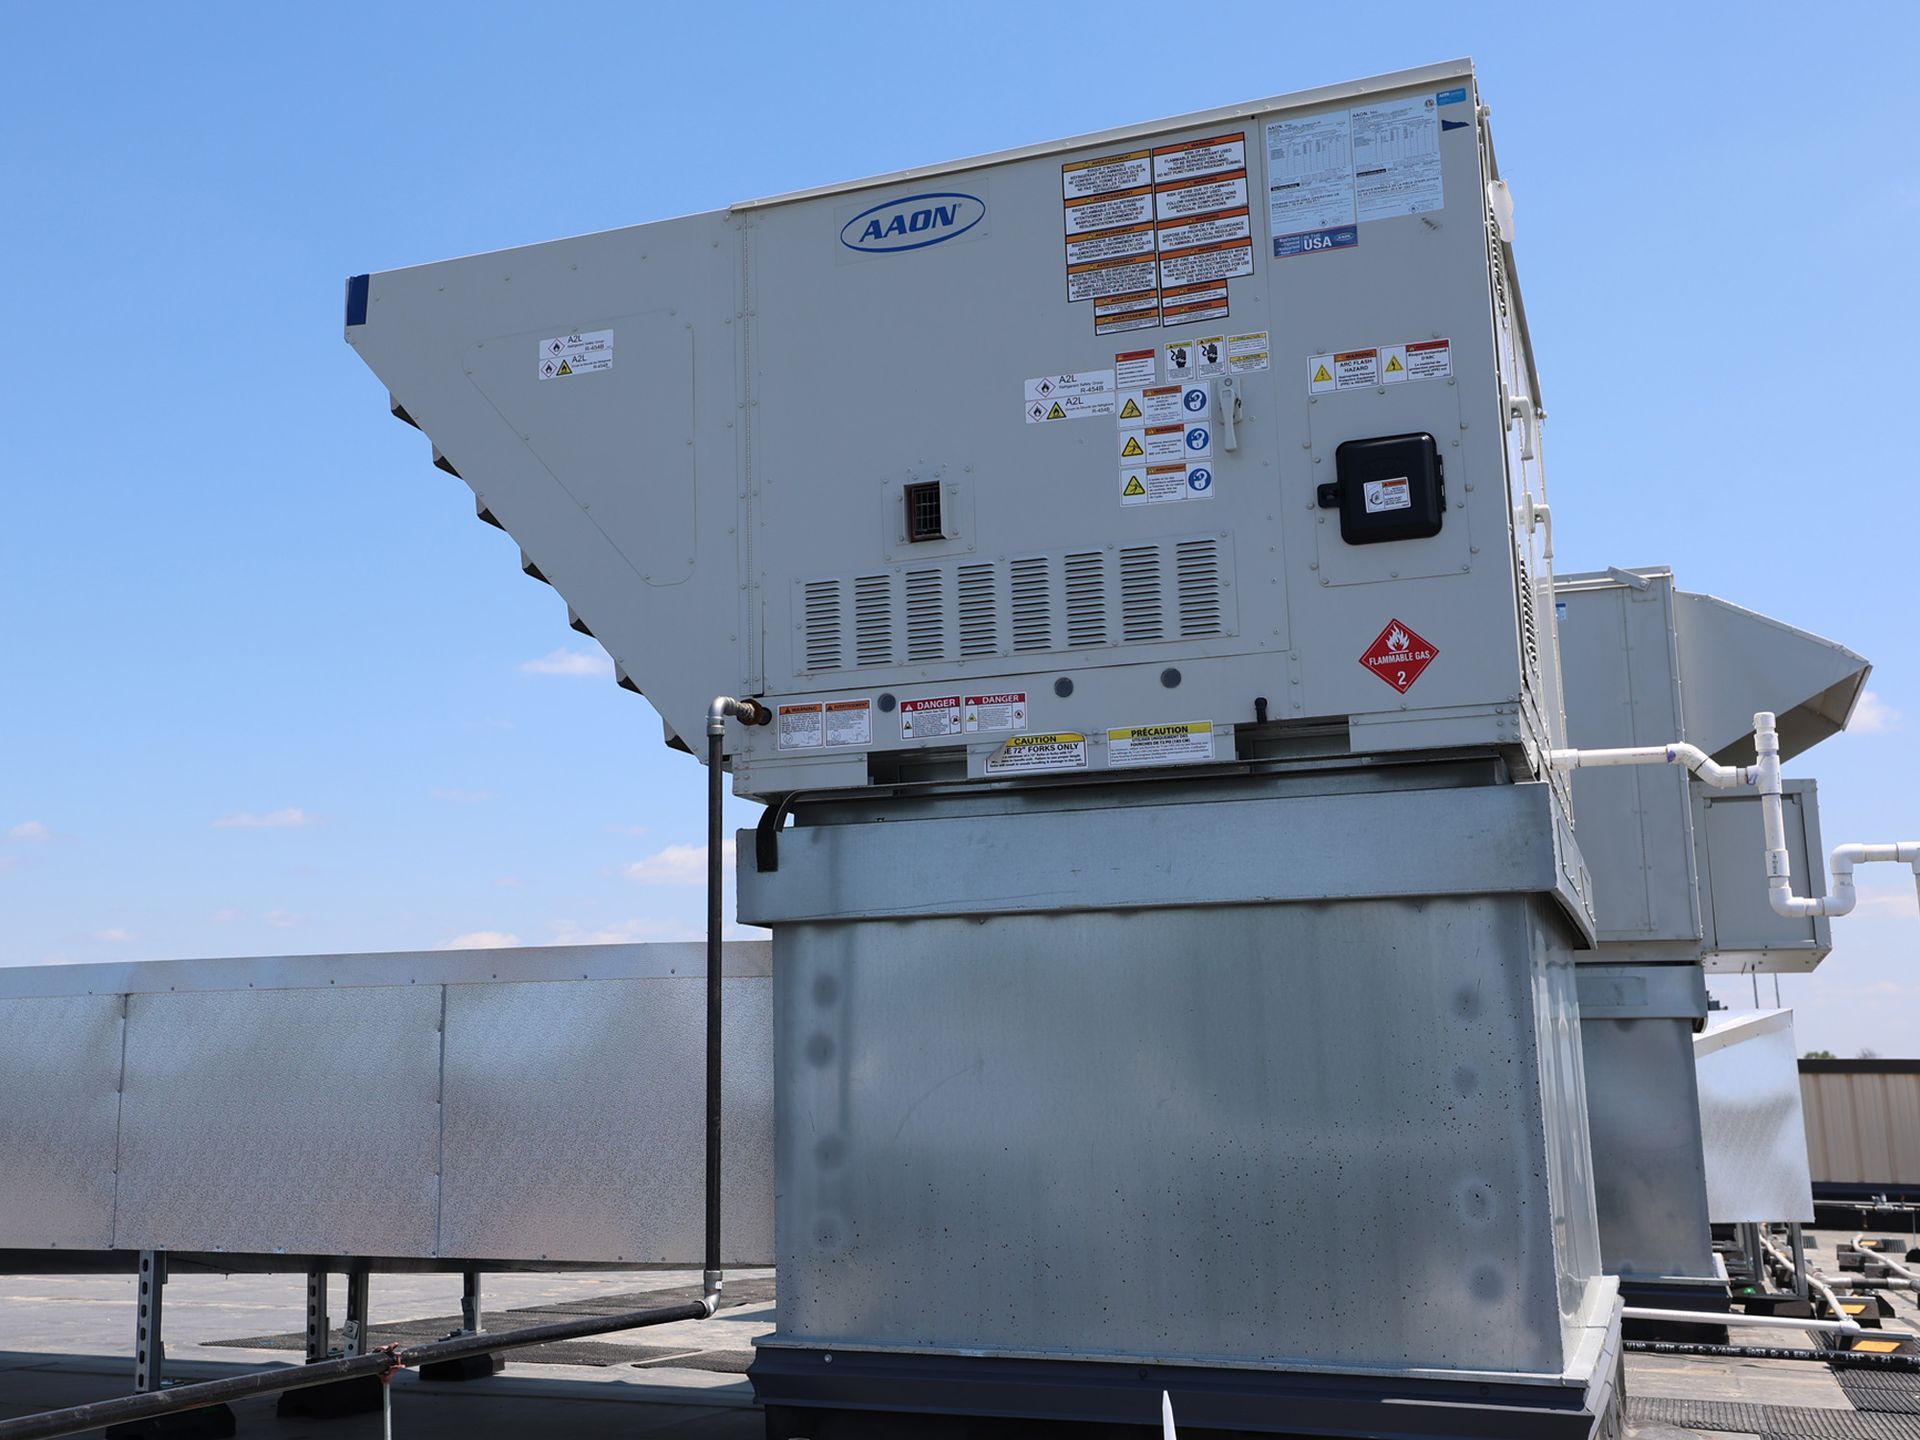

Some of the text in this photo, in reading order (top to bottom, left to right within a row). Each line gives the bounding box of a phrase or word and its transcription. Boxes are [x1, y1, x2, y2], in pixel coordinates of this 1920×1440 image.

[858, 203, 957, 242] AAON
[1304, 236, 1331, 250] USA
[568, 335, 582, 343] A2L
[572, 355, 587, 363] A2L
[1059, 375, 1077, 384] A2L
[1081, 385, 1104, 393] R-454B
[1066, 397, 1084, 406] A2L
[1369, 650, 1430, 665] FLAMMABLE GAS
[1397, 671, 1406, 685] 2
[917, 699, 956, 709] DANGER
[982, 695, 1019, 704] DANGER
[1131, 726, 1188, 737] PRÉCAUTION
[1014, 736, 1056, 745] CAUTION
[1028, 745, 1055, 753] FORKS
[1057, 743, 1079, 751] ONLY
